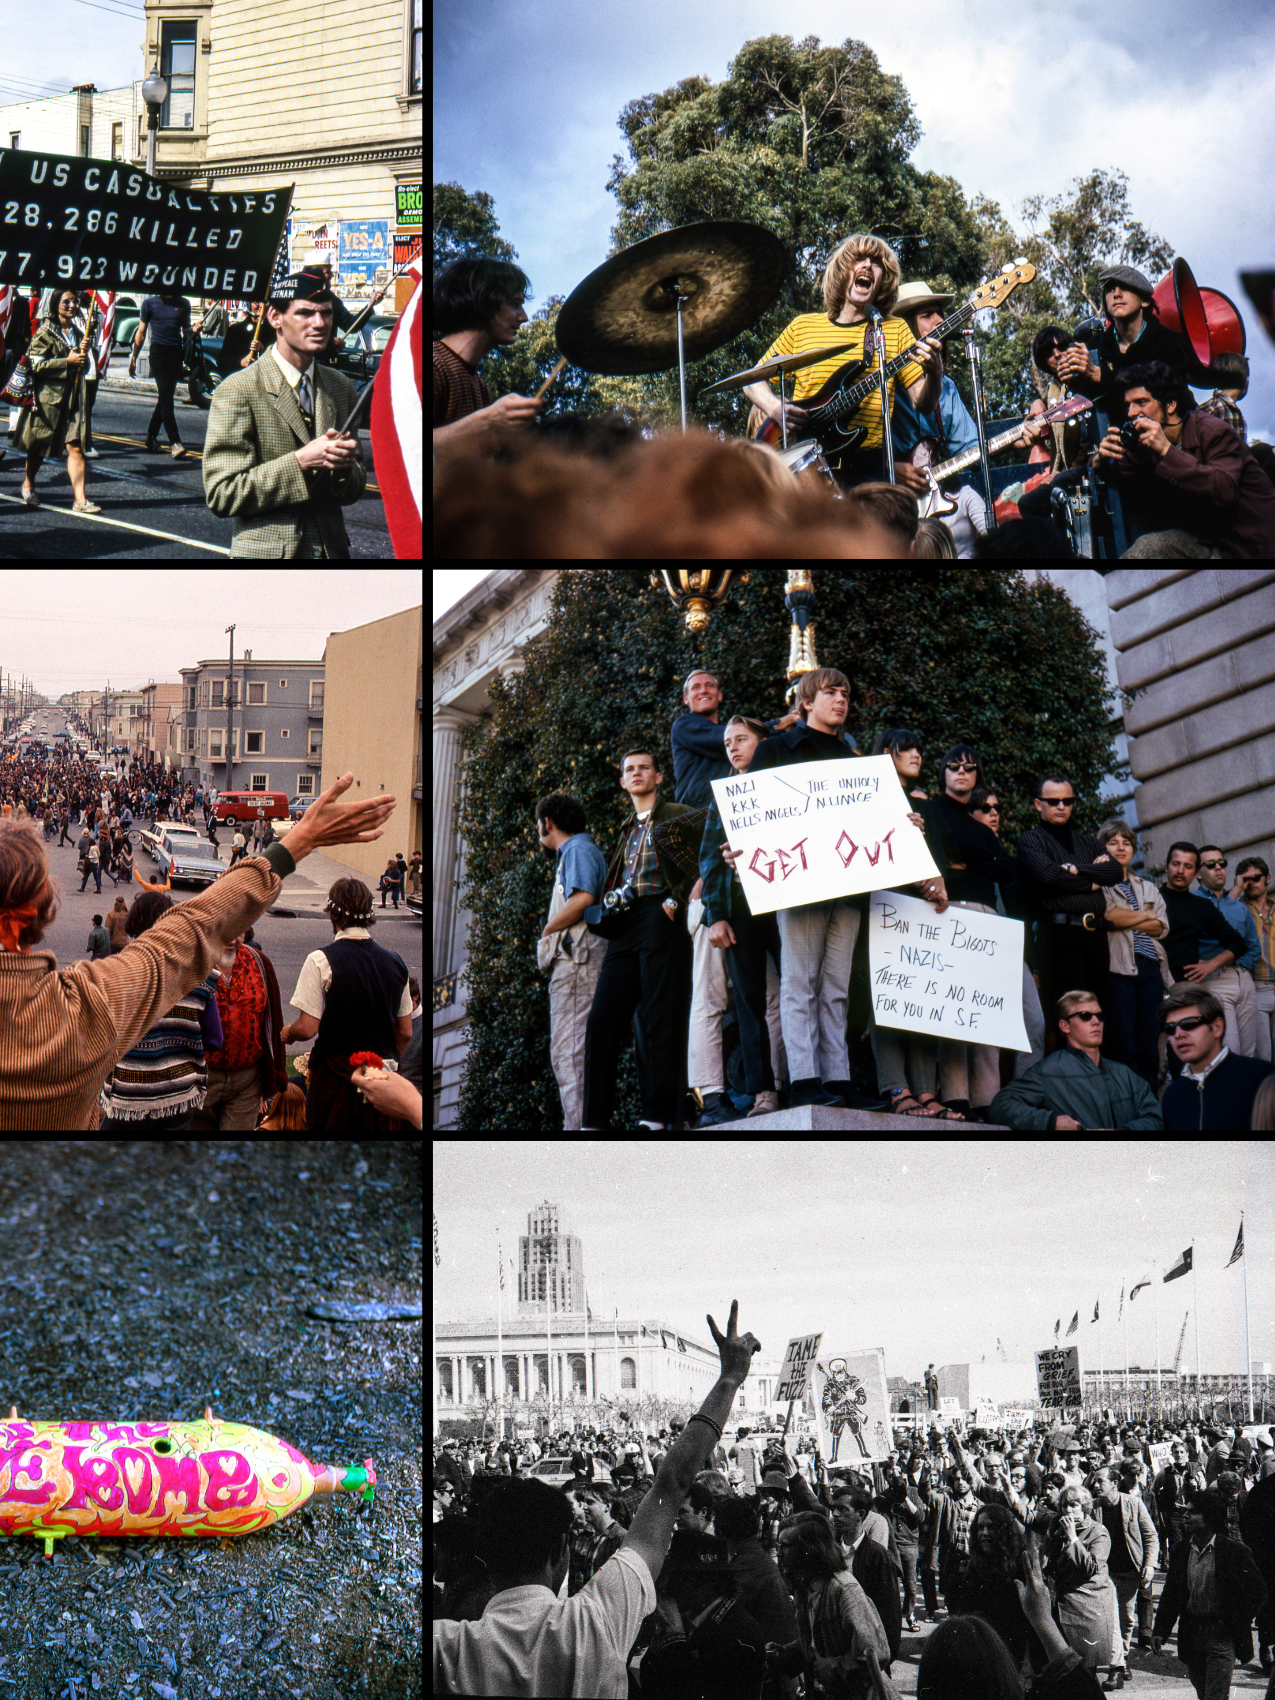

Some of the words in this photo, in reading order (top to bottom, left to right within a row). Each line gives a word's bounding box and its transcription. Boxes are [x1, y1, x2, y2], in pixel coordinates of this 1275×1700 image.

[31, 159, 70, 187] US
[84, 167, 277, 214] CASUALTIES
[129, 216, 243, 249] KILLED
[119, 260, 258, 292] WOUNDED
[726, 780, 756, 797] NAZI
[808, 779, 829, 793] THE
[838, 777, 880, 792] UNHOLY
[732, 798, 761, 814] KKK
[816, 792, 873, 809] ALLIANCE
[729, 813, 761, 831] HELLS
[748, 837, 809, 884] GET
[835, 827, 896, 869] OUT
[924, 980, 938, 995] IS
[945, 984, 966, 1002] NO
[971, 990, 1004, 1011] ROOM
[875, 994, 897, 1013] FOR
[903, 1000, 924, 1018] YOU
[929, 1005, 945, 1022] IN
[787, 1334, 821, 1363] TAME
[1038, 1352, 1051, 1361] WE
[1052, 1350, 1072, 1360] CRY
[1038, 1361, 1065, 1372] FROM
[1043, 1368, 1074, 1380] GRIEF
[776, 1379, 807, 1401] FUZZ
[1039, 1381, 1051, 1390] FOR
[1052, 1380, 1064, 1388] OUR
[1040, 1396, 1063, 1409] TEAR
[1065, 1394, 1082, 1407] GAS
